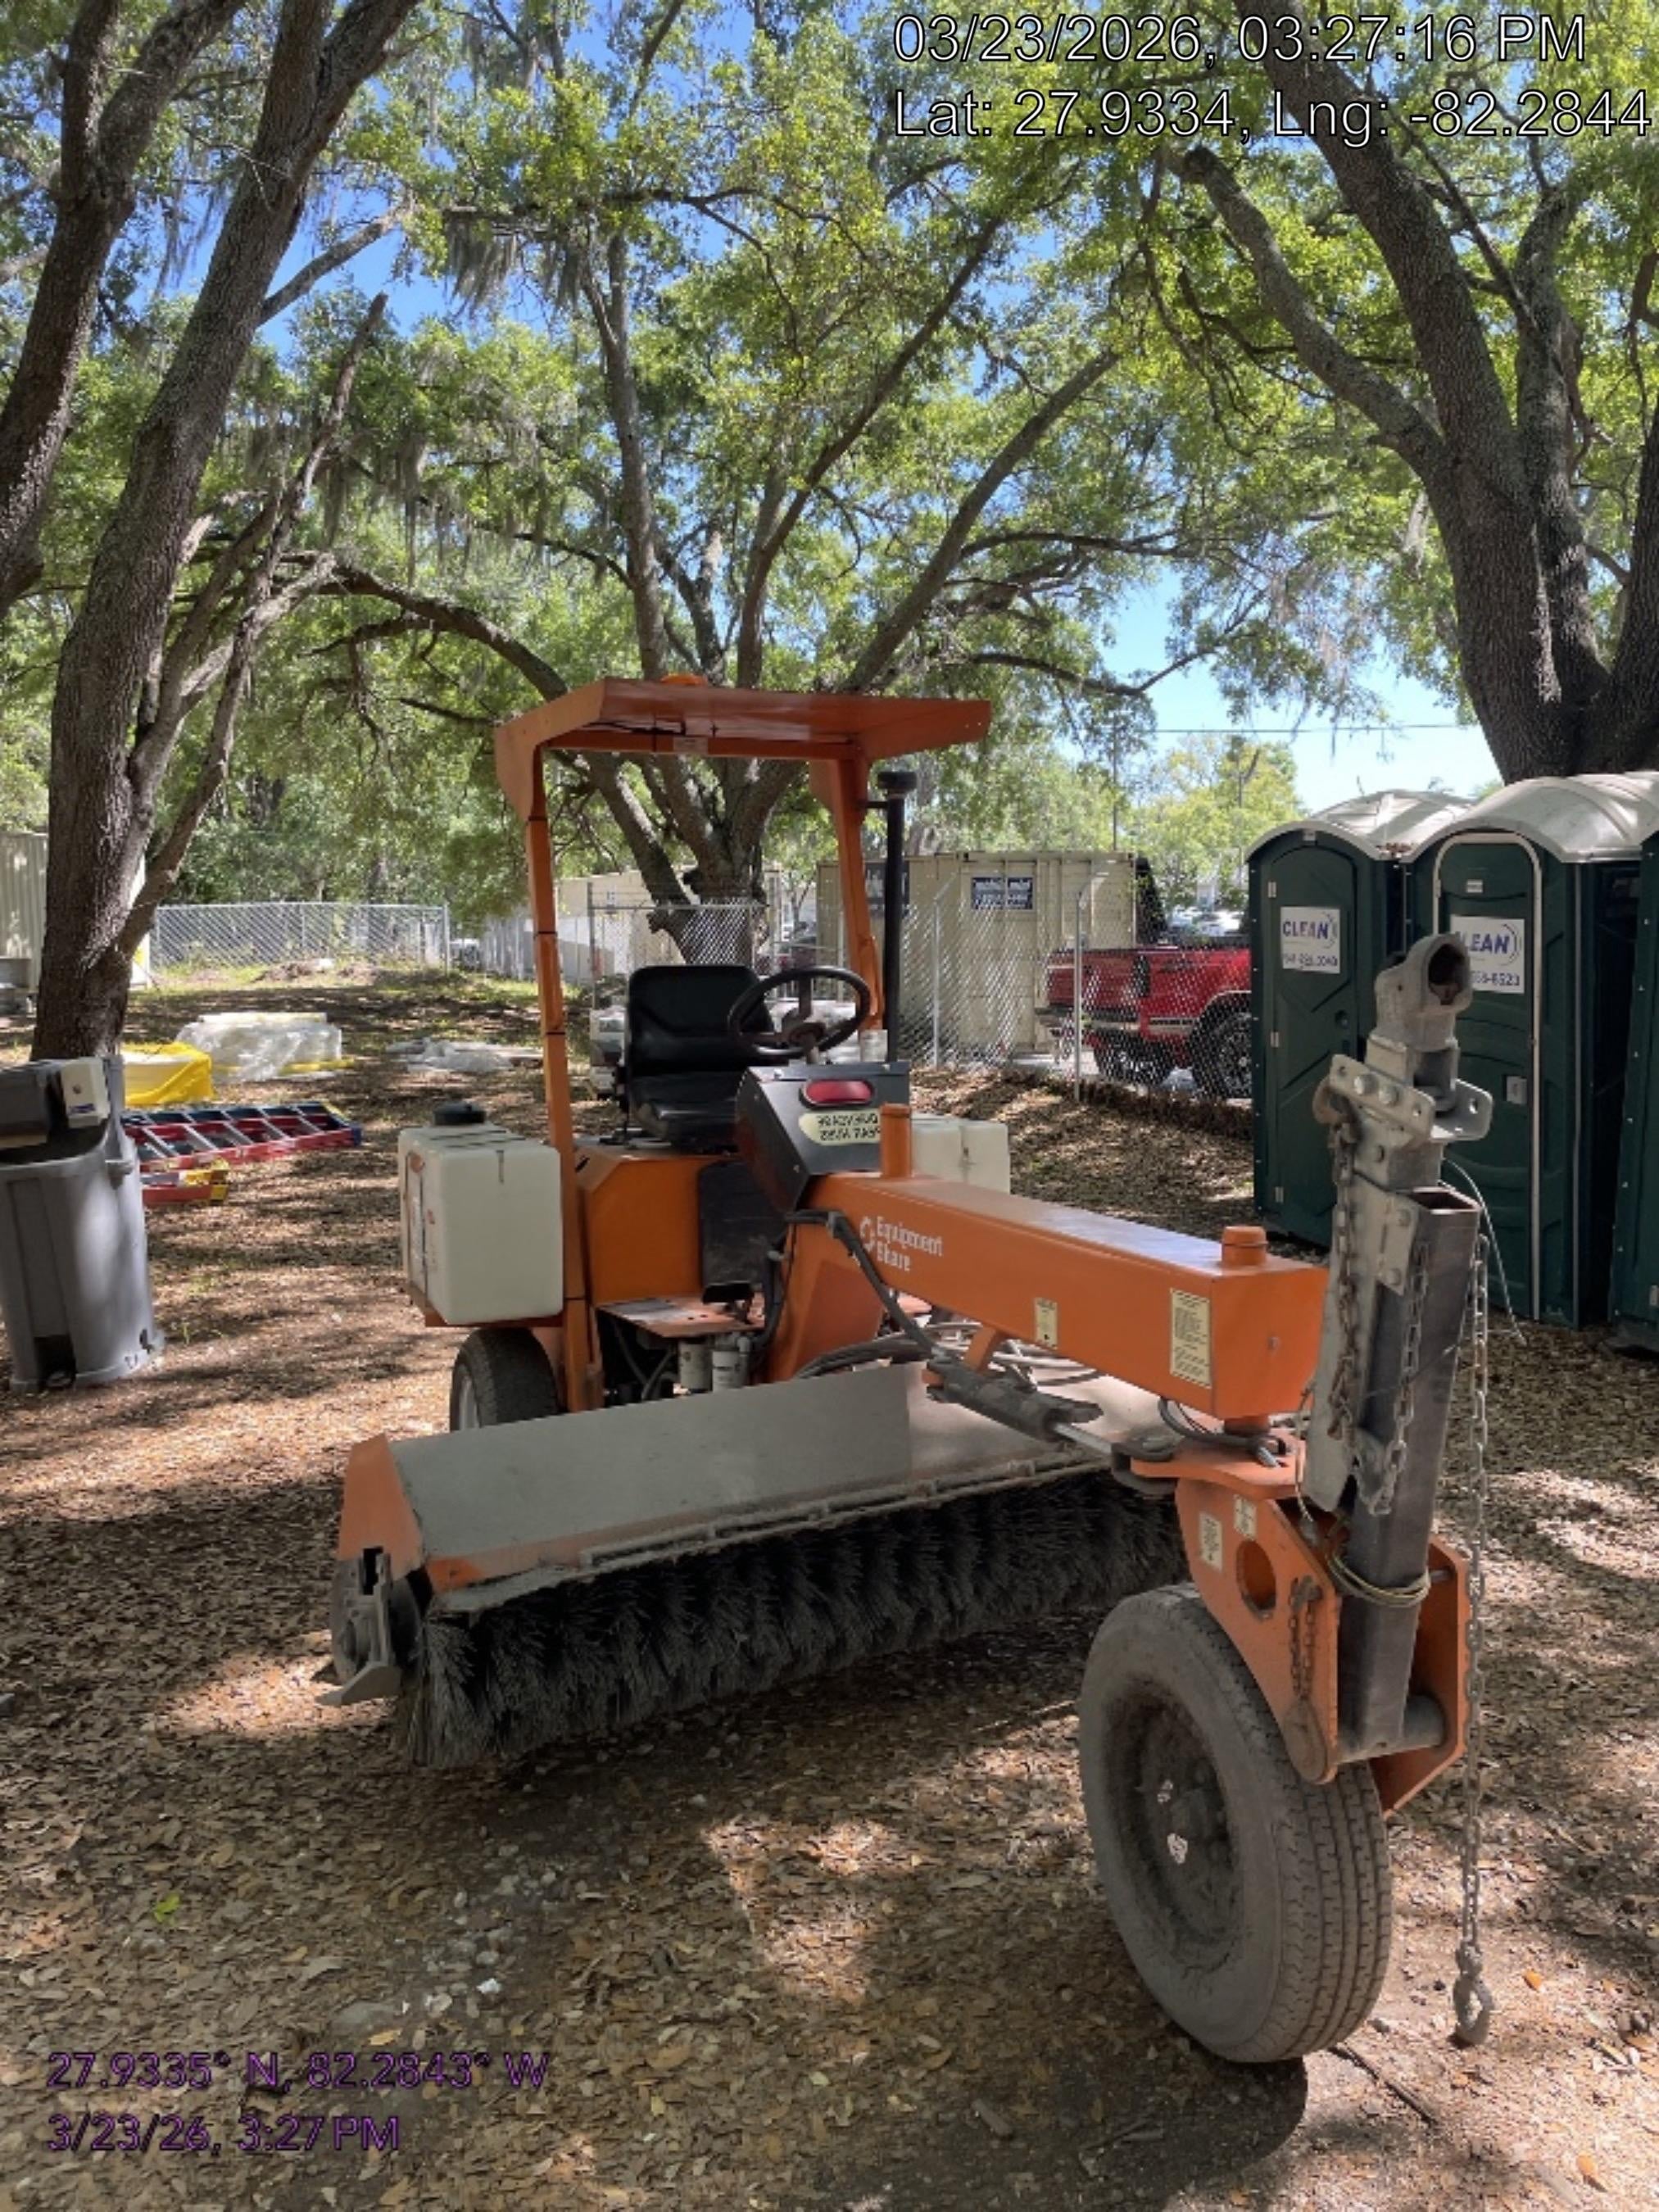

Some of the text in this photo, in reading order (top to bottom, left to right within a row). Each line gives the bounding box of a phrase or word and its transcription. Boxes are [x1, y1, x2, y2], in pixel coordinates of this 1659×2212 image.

[1283, 921, 1329, 940] CLEAN
[1455, 931, 1510, 954] LEAN
[877, 1217, 942, 1257] Equipment
[877, 1240, 910, 1271] Share
